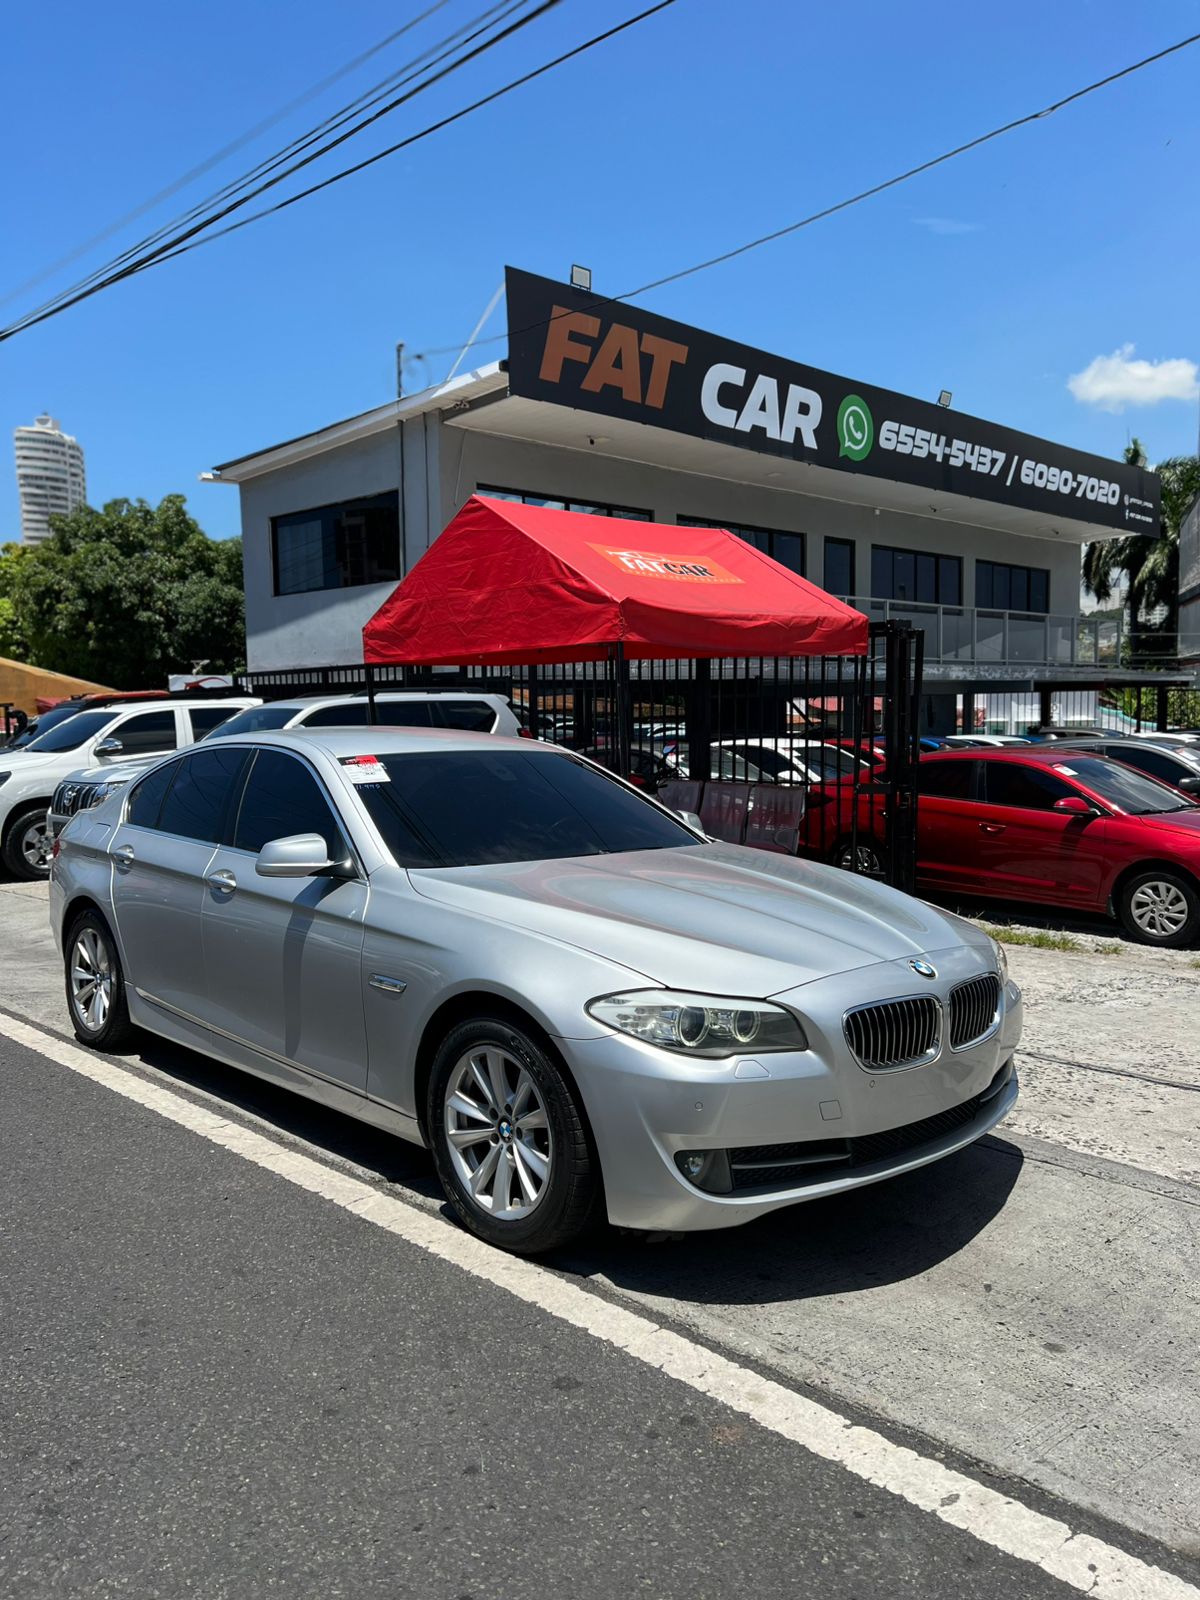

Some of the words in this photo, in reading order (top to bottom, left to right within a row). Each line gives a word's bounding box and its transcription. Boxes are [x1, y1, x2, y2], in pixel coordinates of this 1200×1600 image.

[539, 304, 689, 409] FAT
[700, 363, 823, 450] CAR
[879, 420, 1007, 477] 6554-5437
[1020, 459, 1121, 506] 6090-7020
